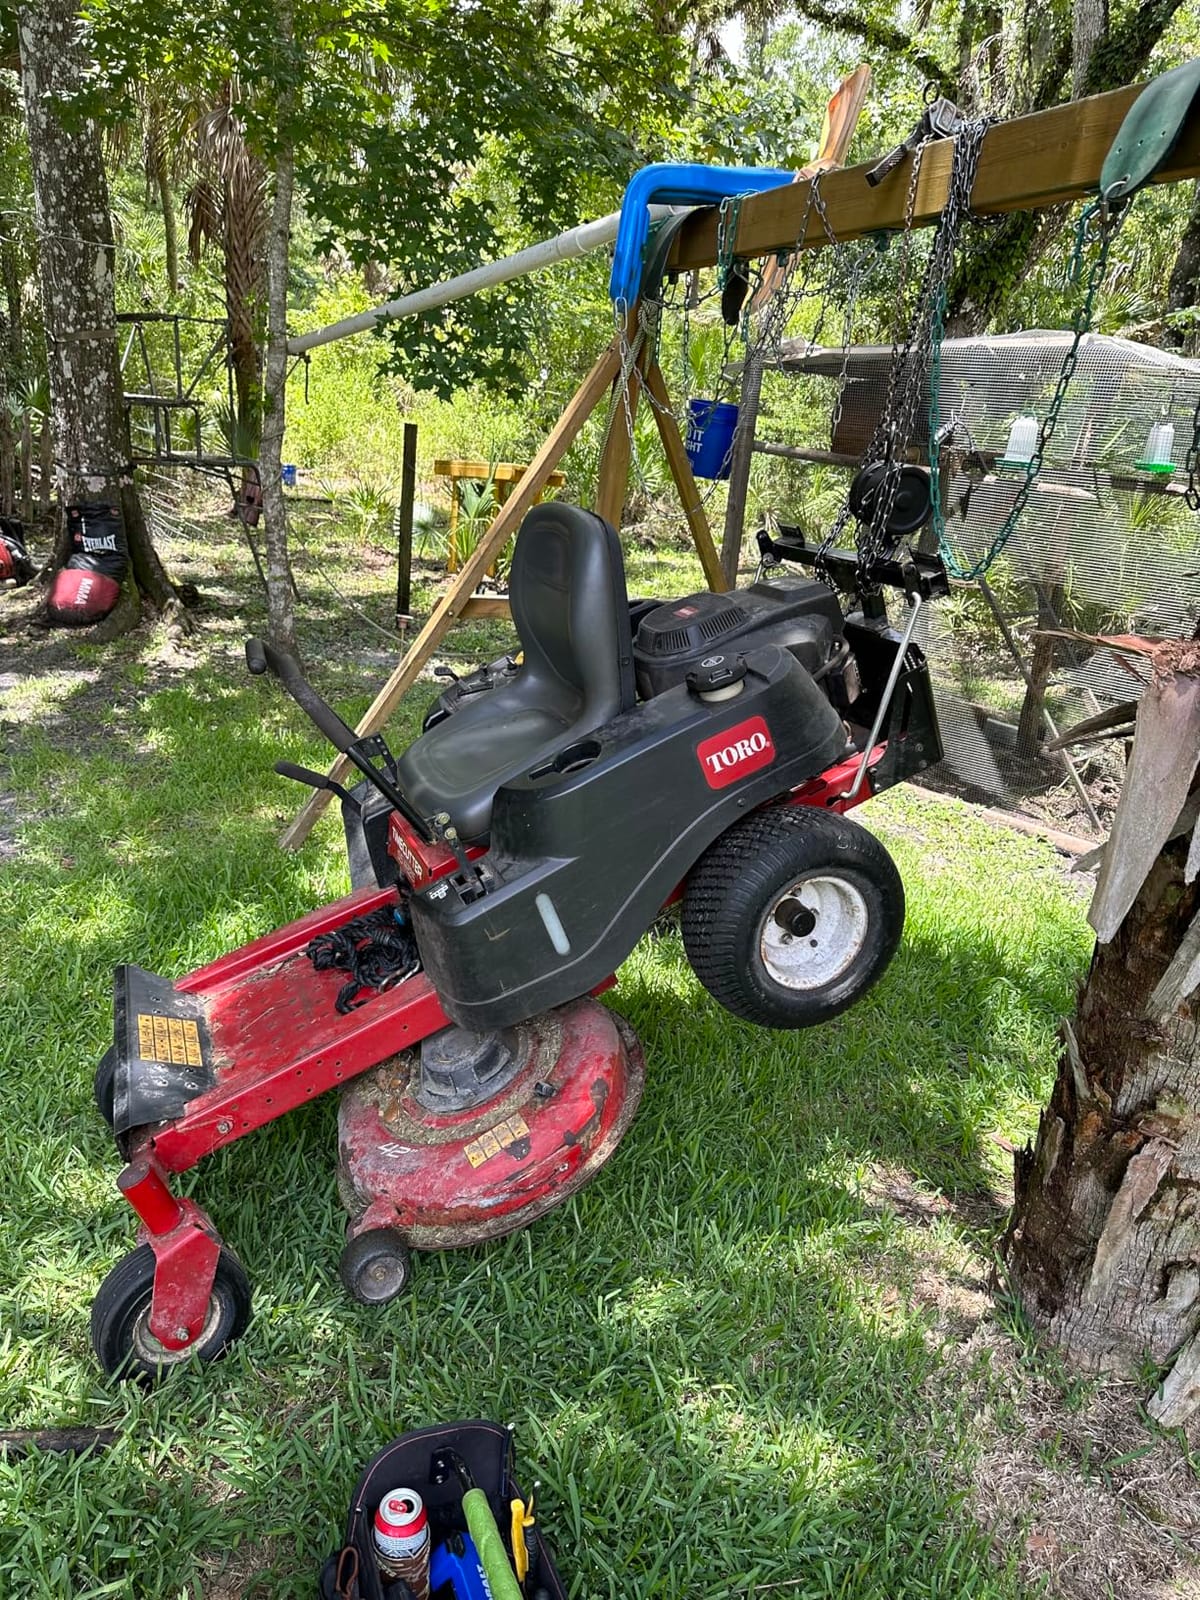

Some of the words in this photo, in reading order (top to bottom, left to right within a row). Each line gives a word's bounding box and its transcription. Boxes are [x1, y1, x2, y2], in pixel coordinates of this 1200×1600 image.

[693, 429, 705, 441] IT
[81, 534, 118, 552] EVERLAST
[74, 577, 93, 605] MMA
[705, 732, 767, 774] TORO
[392, 826, 423, 881] TIMECUTTER
